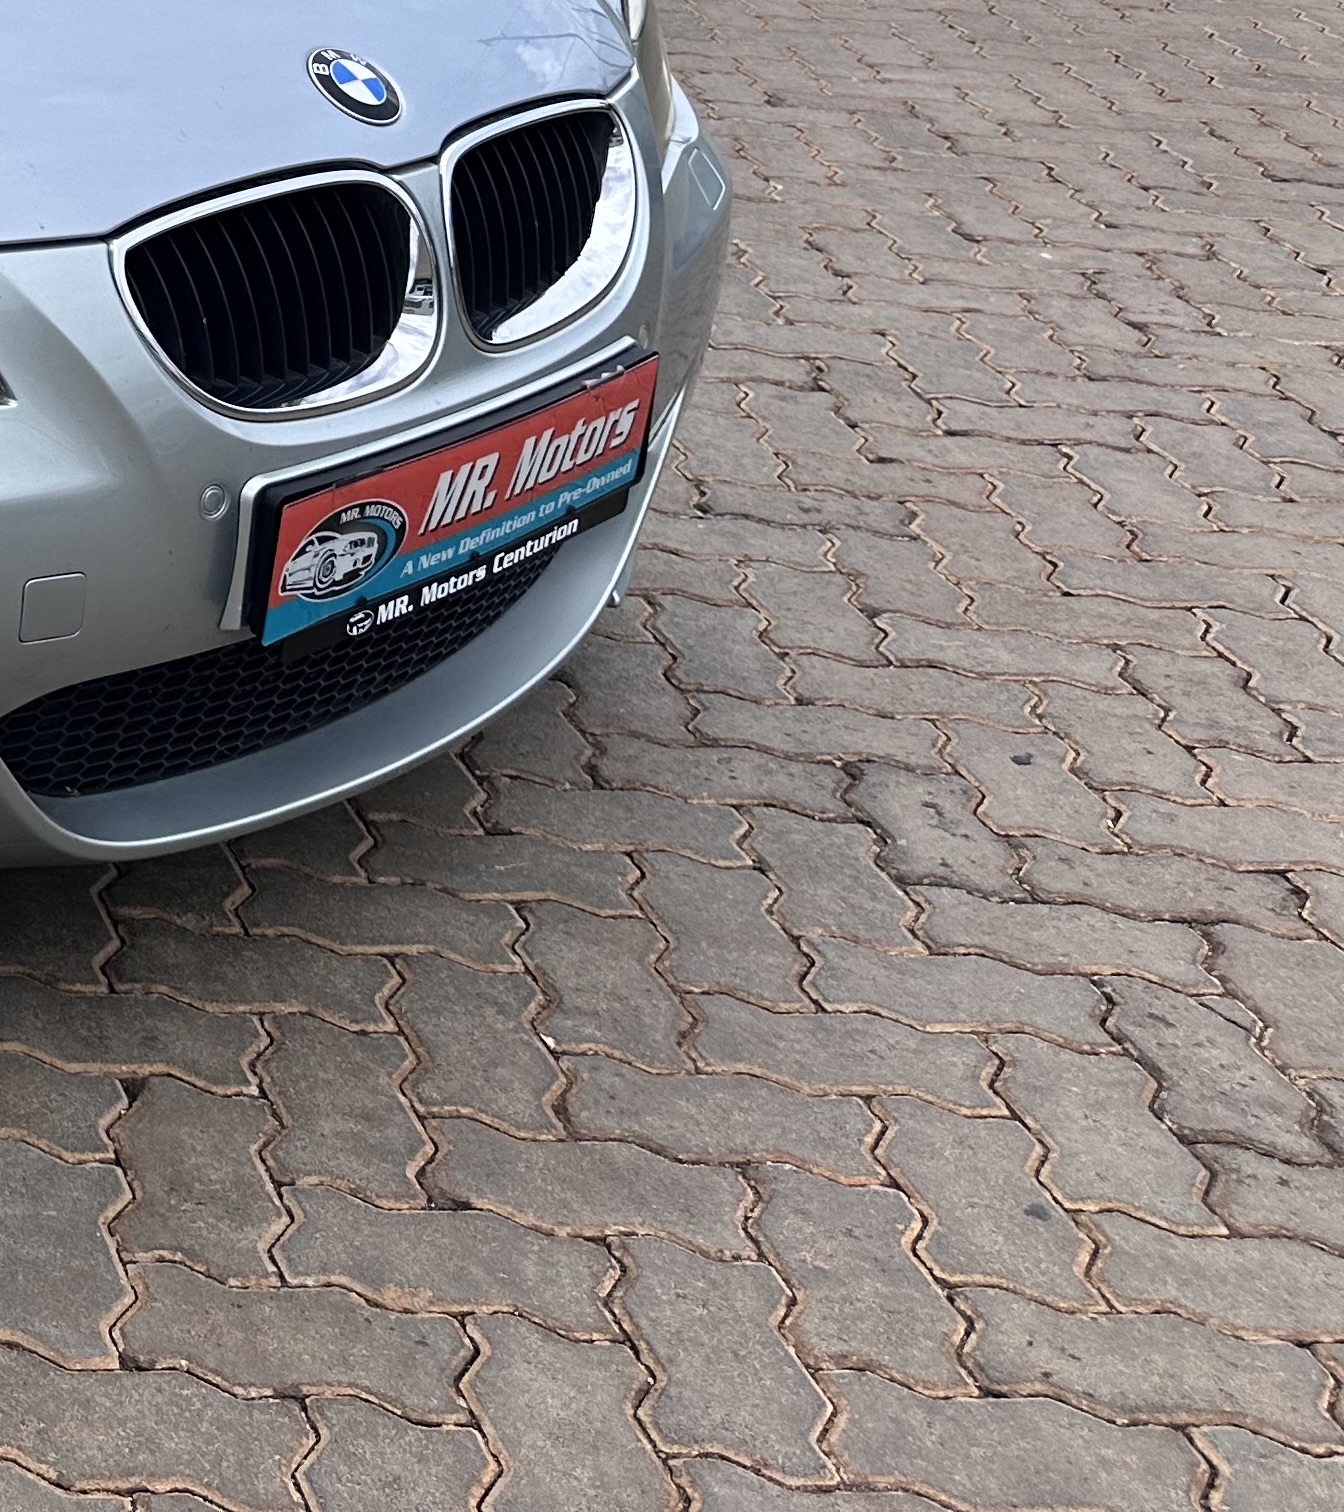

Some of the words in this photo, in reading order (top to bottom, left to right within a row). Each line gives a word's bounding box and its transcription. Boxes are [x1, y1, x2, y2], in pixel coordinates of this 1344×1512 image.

[339, 507, 362, 525] MR.
[363, 504, 404, 530] MOTORS
[400, 560, 413, 578] A
[418, 545, 454, 572] New
[458, 510, 536, 554] Definition
[538, 499, 556, 519] to
[557, 459, 632, 510] Pre-Owned
[418, 452, 499, 536] MR.
[505, 398, 641, 500] Motors
[376, 596, 414, 625] MR.
[420, 564, 487, 607] Motors
[492, 518, 580, 574] Centurion
